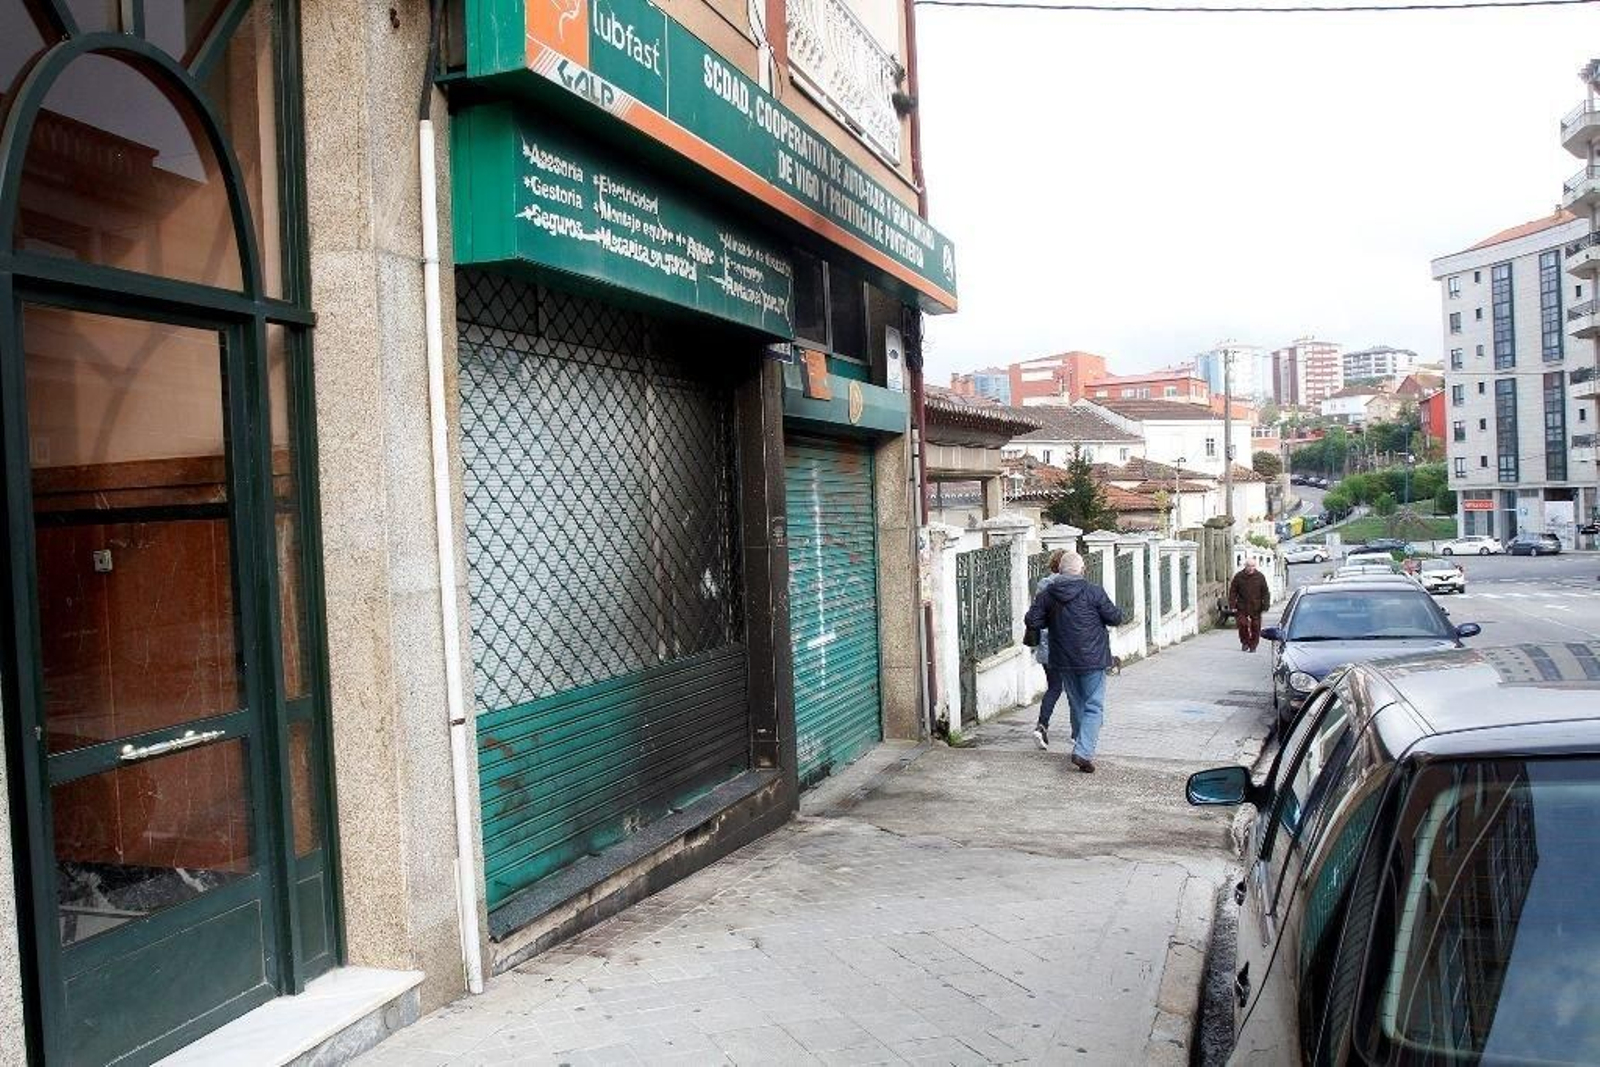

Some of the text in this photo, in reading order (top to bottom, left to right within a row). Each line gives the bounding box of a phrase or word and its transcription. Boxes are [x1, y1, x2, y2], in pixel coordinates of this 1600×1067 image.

[557, 58, 615, 107] GALP
[703, 54, 753, 119] SCDAD.
[756, 95, 829, 176] COOPERATIVA
[830, 152, 842, 185] DE
[530, 175, 583, 210] Gestoria
[778, 149, 793, 185] DE
[794, 161, 820, 203] VIGO
[828, 184, 874, 238] PROVINCIA
[873, 216, 885, 245] DE
[530, 203, 584, 240] Seguros
